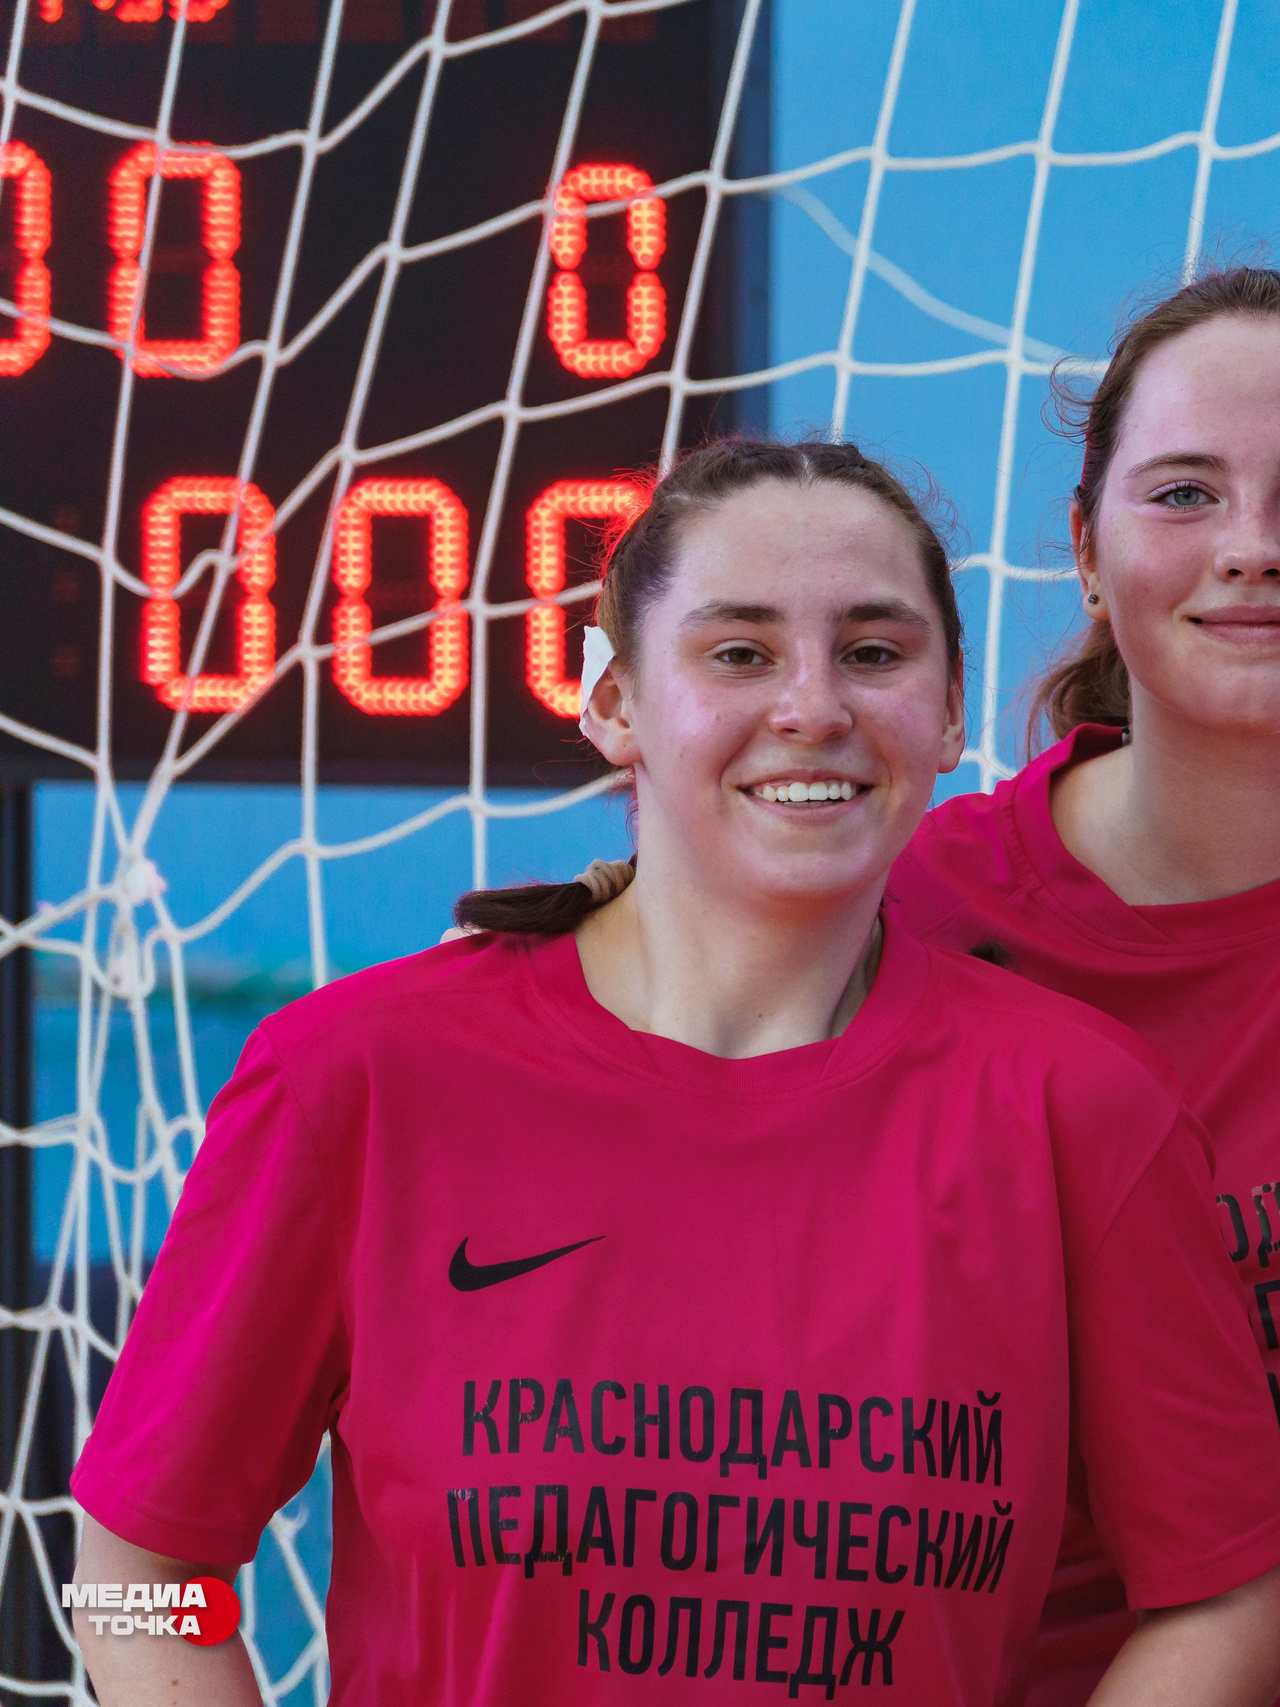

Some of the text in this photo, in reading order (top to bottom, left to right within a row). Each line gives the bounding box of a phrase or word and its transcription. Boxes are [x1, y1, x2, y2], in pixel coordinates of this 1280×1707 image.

[548, 163, 666, 378] 0
[462, 1378, 1003, 1487] КРАСНОДАРСКИЙ
[446, 1485, 1015, 1594] ПЕДАГОГИЧЕСКИЙ
[577, 1588, 905, 1700] КОЛЛЕДЖ
